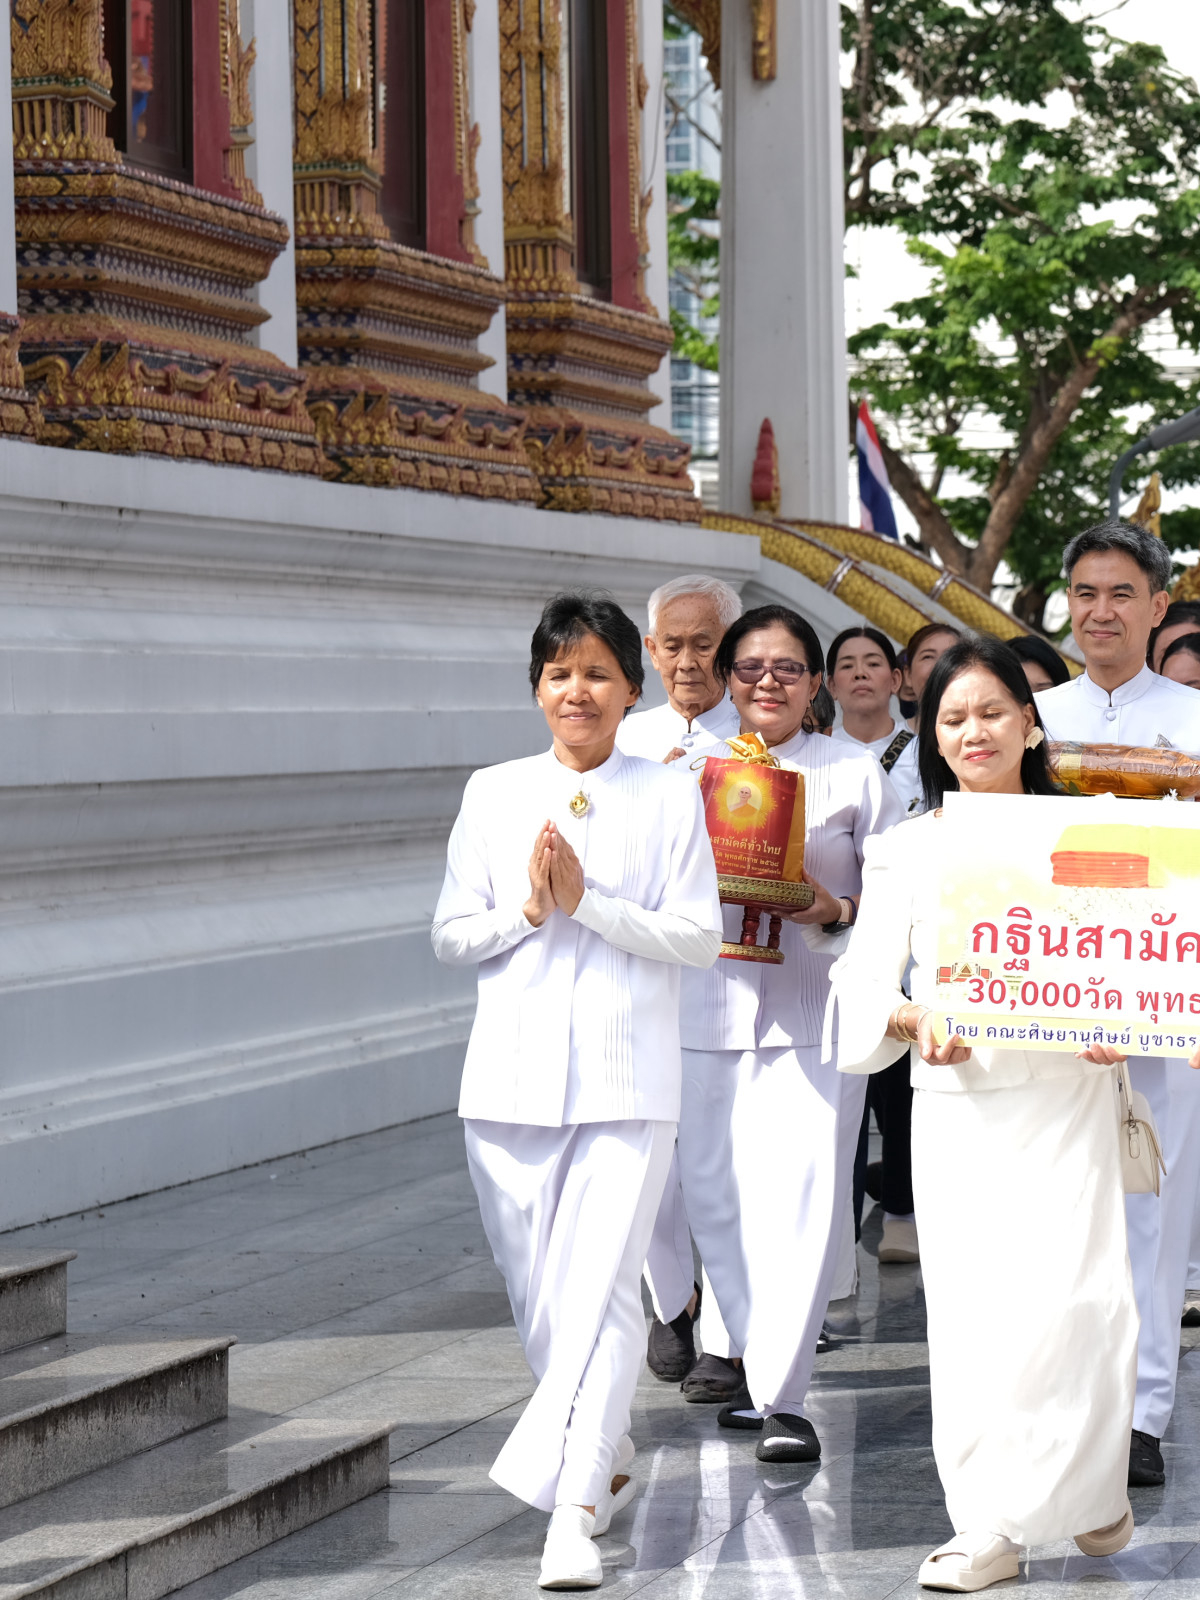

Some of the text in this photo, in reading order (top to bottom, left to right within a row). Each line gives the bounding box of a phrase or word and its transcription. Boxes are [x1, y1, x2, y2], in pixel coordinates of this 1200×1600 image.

[968, 976, 1123, 1011] 30,000วัด
[945, 1017, 979, 1038] โดย
[986, 1022, 1132, 1048] คณะศิษยานุศิษย์
